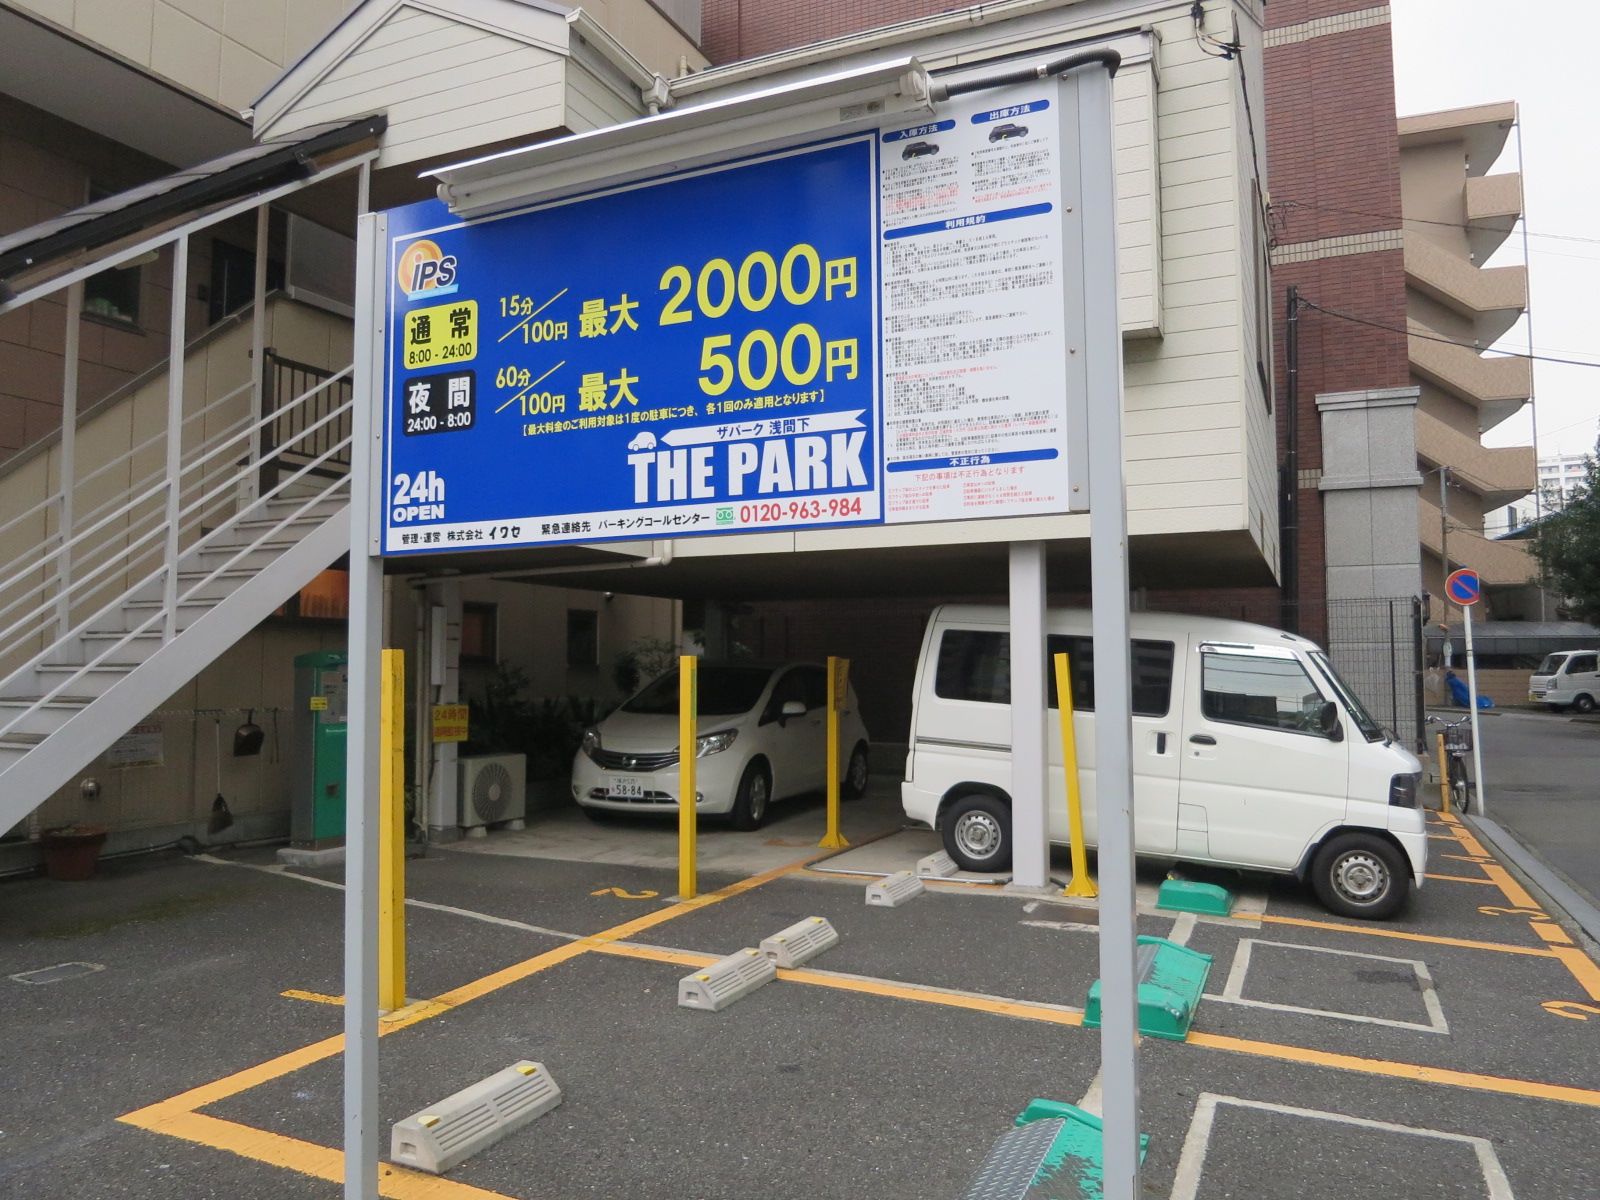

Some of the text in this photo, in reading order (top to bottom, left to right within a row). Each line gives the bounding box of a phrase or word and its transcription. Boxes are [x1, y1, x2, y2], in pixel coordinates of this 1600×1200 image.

[945, 213, 986, 230] 利用規約
[499, 294, 534, 317] 15分
[522, 319, 568, 344] 100円
[578, 293, 640, 339] 最大
[658, 243, 858, 327] 2000円
[409, 306, 472, 346] 通常
[442, 342, 472, 360] 24:00
[495, 365, 531, 389] 60分
[519, 391, 565, 416] 100円
[578, 367, 640, 412] 最大
[698, 322, 858, 397] 500円
[408, 375, 471, 414] 夜間
[407, 415, 437, 433] 24:00
[768, 417, 810, 435] 浅間下
[627, 445, 715, 504] THE
[728, 430, 868, 497] PARK
[949, 455, 991, 467] 不正行為
[392, 470, 445, 505] 24h
[392, 503, 445, 522] OPEN
[446, 529, 484, 541] 株式会社
[488, 525, 521, 540] イワセ
[541, 520, 591, 535] 緊急連絡先
[739, 496, 862, 524] 0120-963-984
